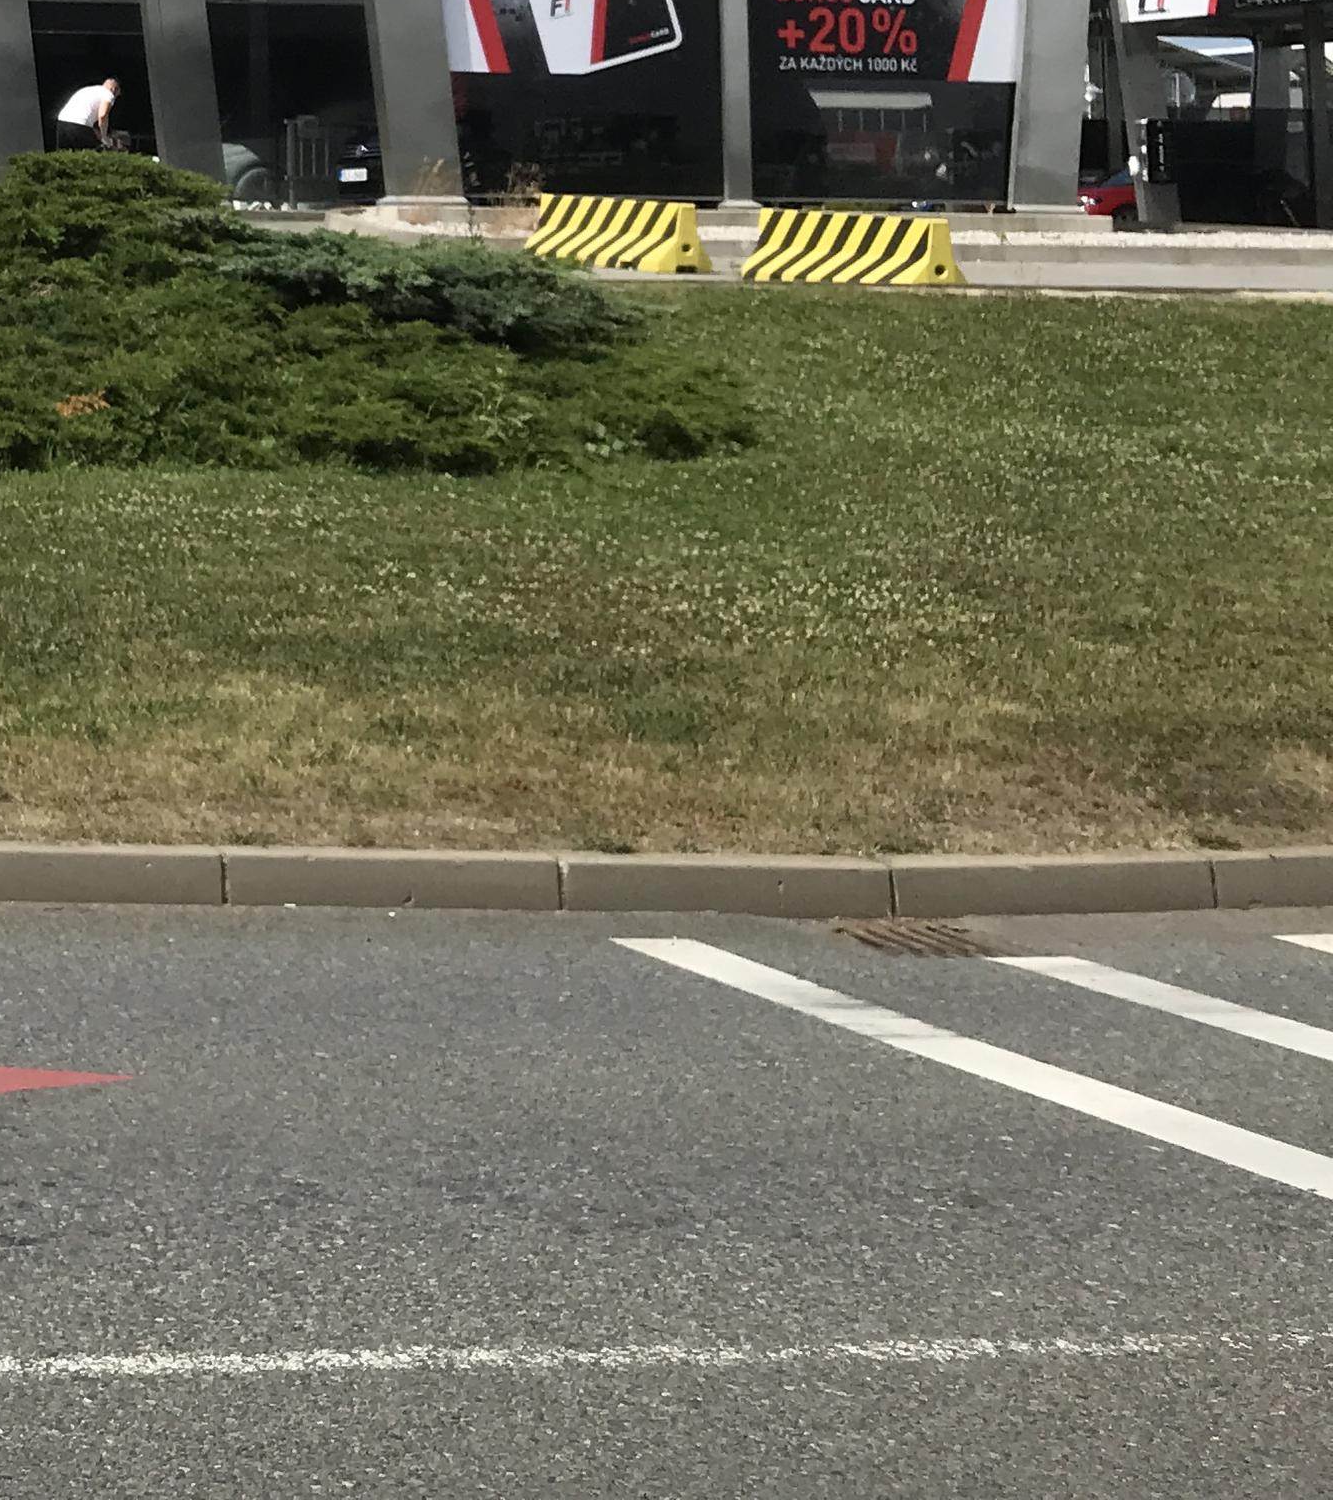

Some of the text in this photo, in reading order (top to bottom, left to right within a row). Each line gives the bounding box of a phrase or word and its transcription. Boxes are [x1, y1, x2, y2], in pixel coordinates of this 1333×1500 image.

[779, 56, 796, 71] ZA
[800, 55, 863, 71] KAŽDÝCH
[868, 58, 897, 71] 1000
